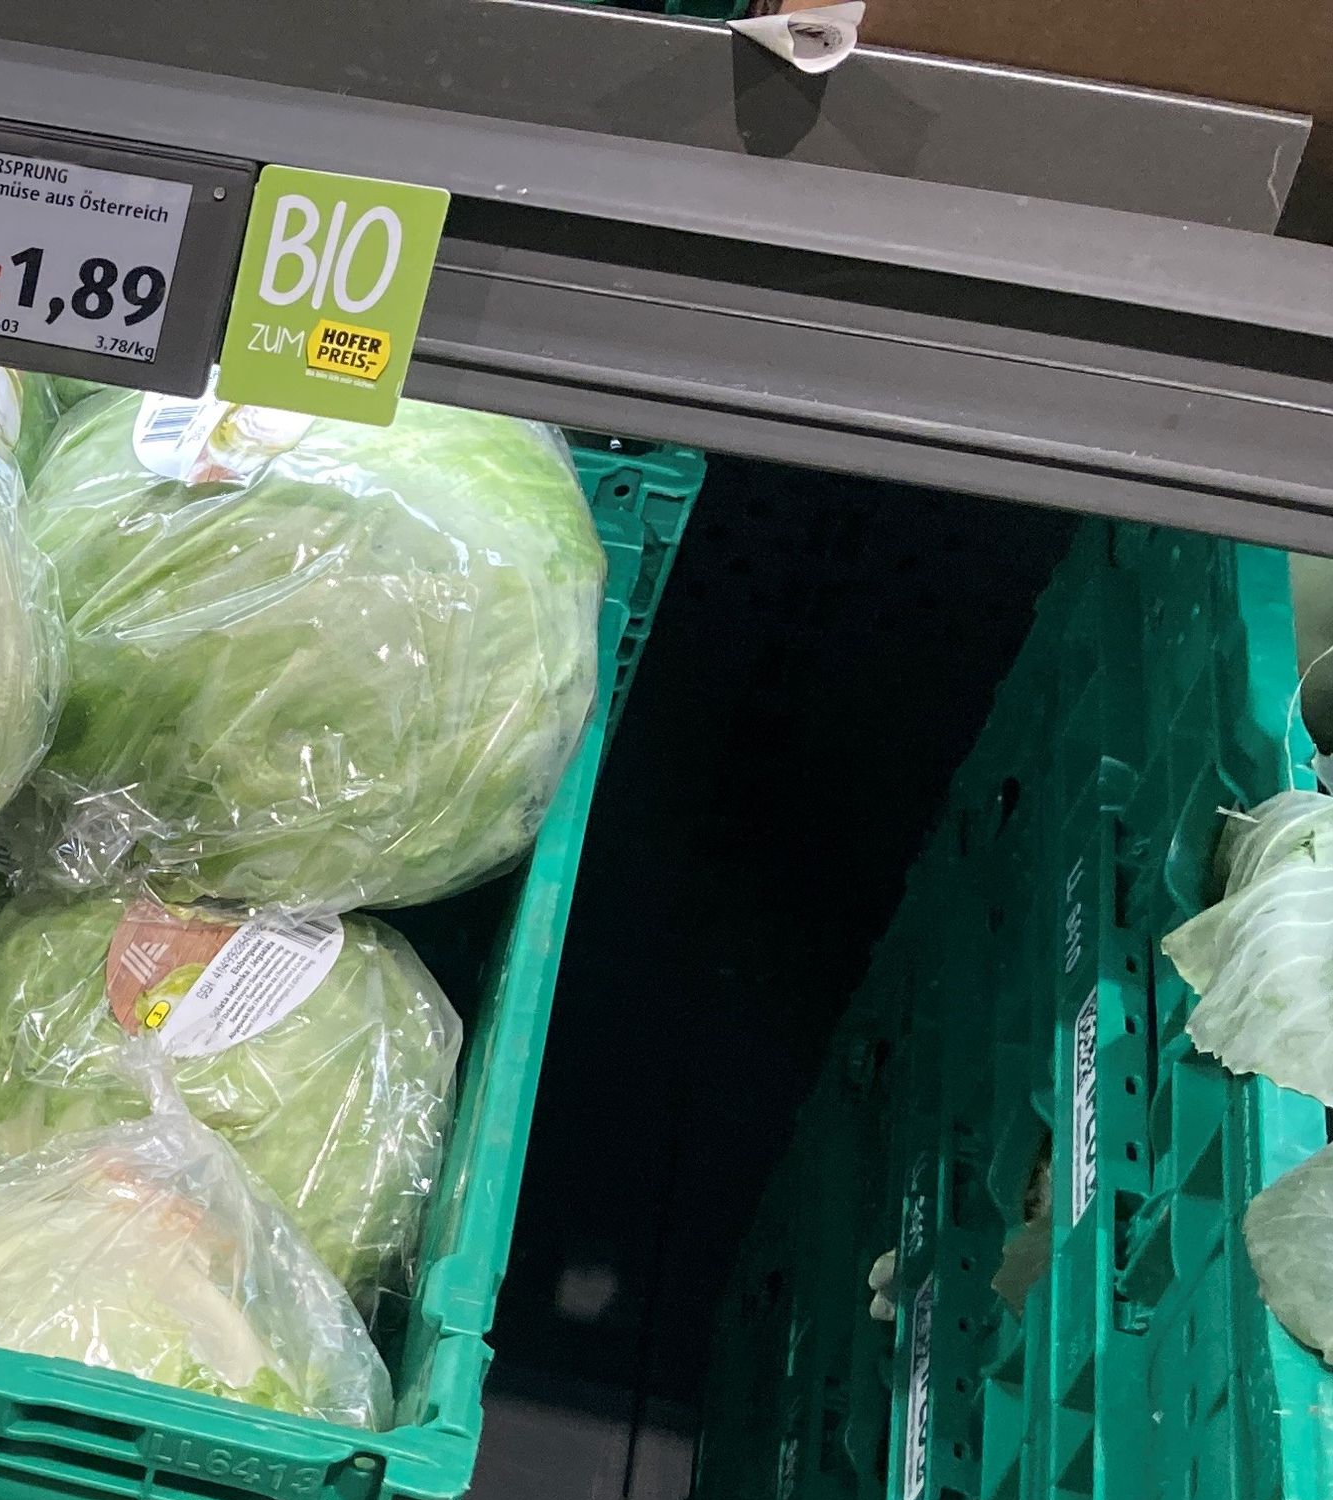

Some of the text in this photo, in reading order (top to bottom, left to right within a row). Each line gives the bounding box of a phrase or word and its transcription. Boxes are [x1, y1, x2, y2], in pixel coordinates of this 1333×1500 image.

[45, 190, 75, 209] aus
[79, 189, 169, 224] Österreich
[258, 194, 402, 314] BIO
[11, 246, 167, 328] 1,89
[95, 335, 156, 362] 3,78/kg
[247, 323, 383, 358] ZUM HOFER
[225, 966, 250, 998] ledenka
